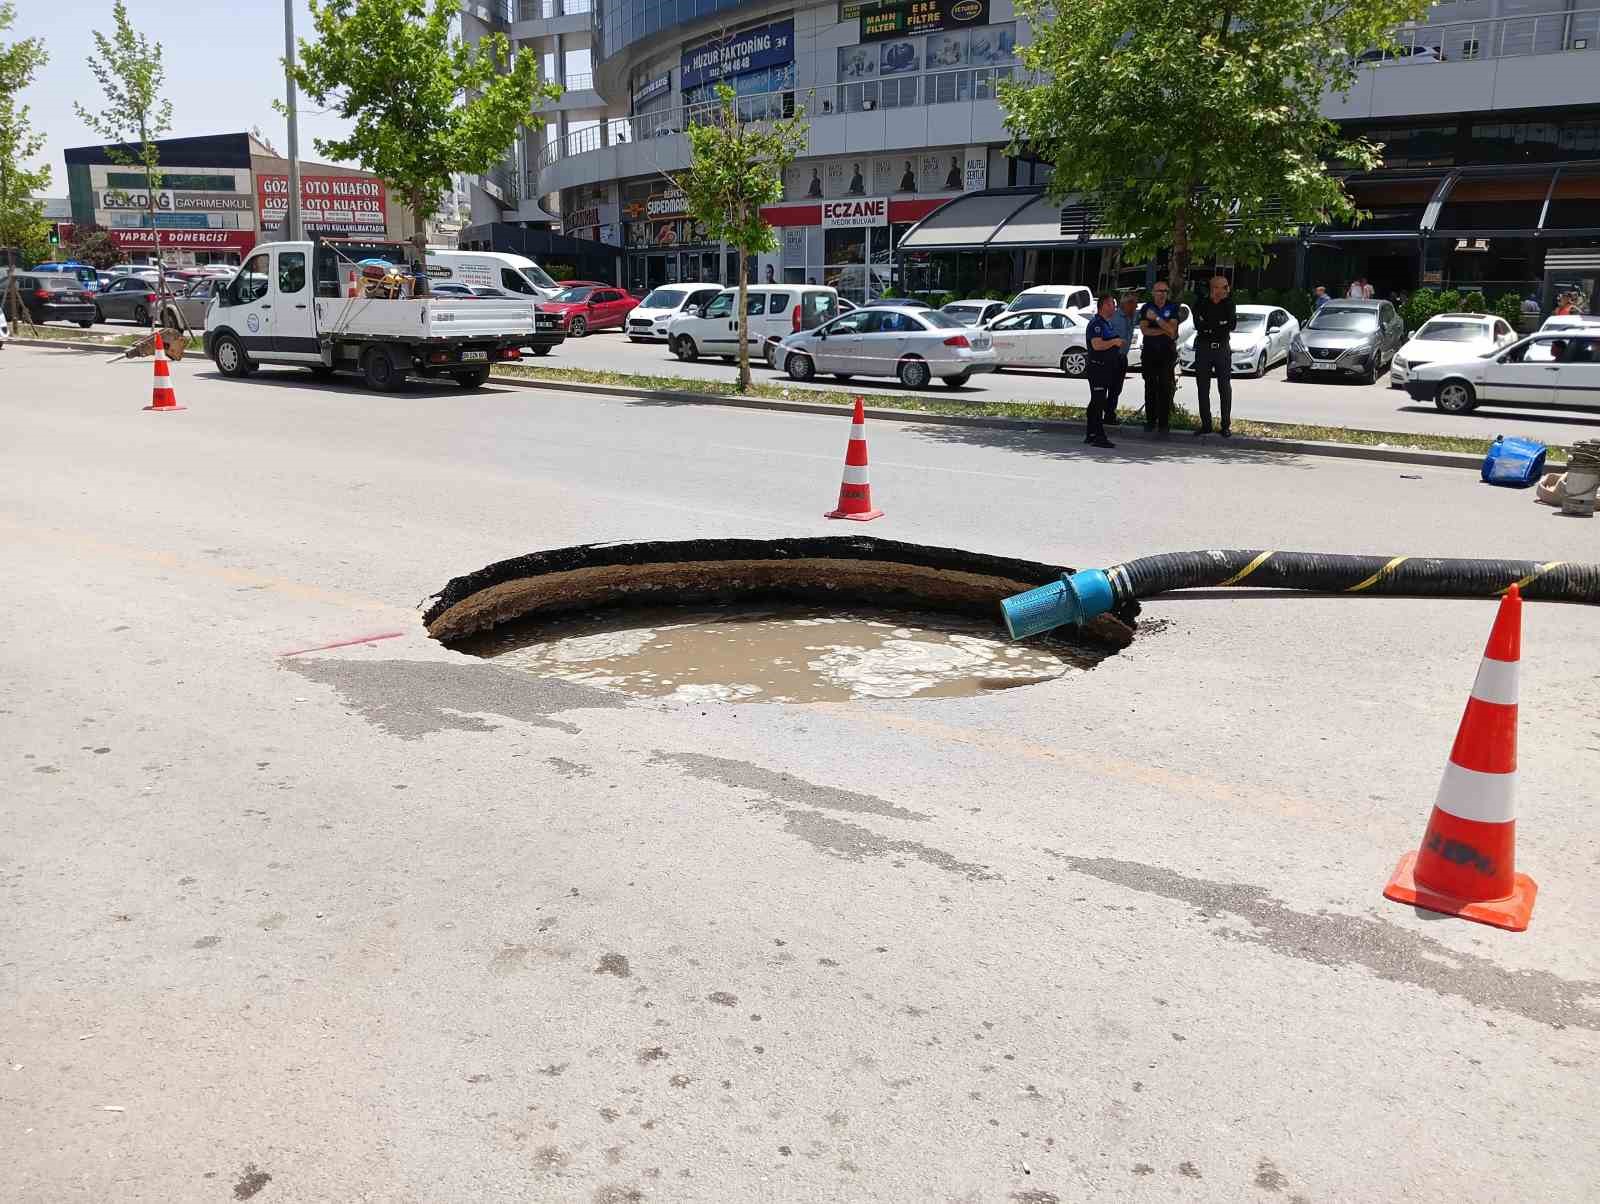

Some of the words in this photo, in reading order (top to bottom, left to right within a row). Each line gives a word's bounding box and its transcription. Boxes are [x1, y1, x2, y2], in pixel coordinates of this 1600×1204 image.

[912, 1, 936, 12] ERE
[866, 12, 896, 25] MANN
[866, 22, 896, 34] FILTER
[720, 35, 771, 61] FAKTORİNG
[305, 181, 329, 194] OTO
[332, 179, 379, 196] KUAFÖR
[306, 199, 330, 210] OTO
[333, 198, 380, 211] KUAFÖR
[824, 200, 884, 218] ECZANE
[168, 230, 228, 242] DÖNERCİSİ
